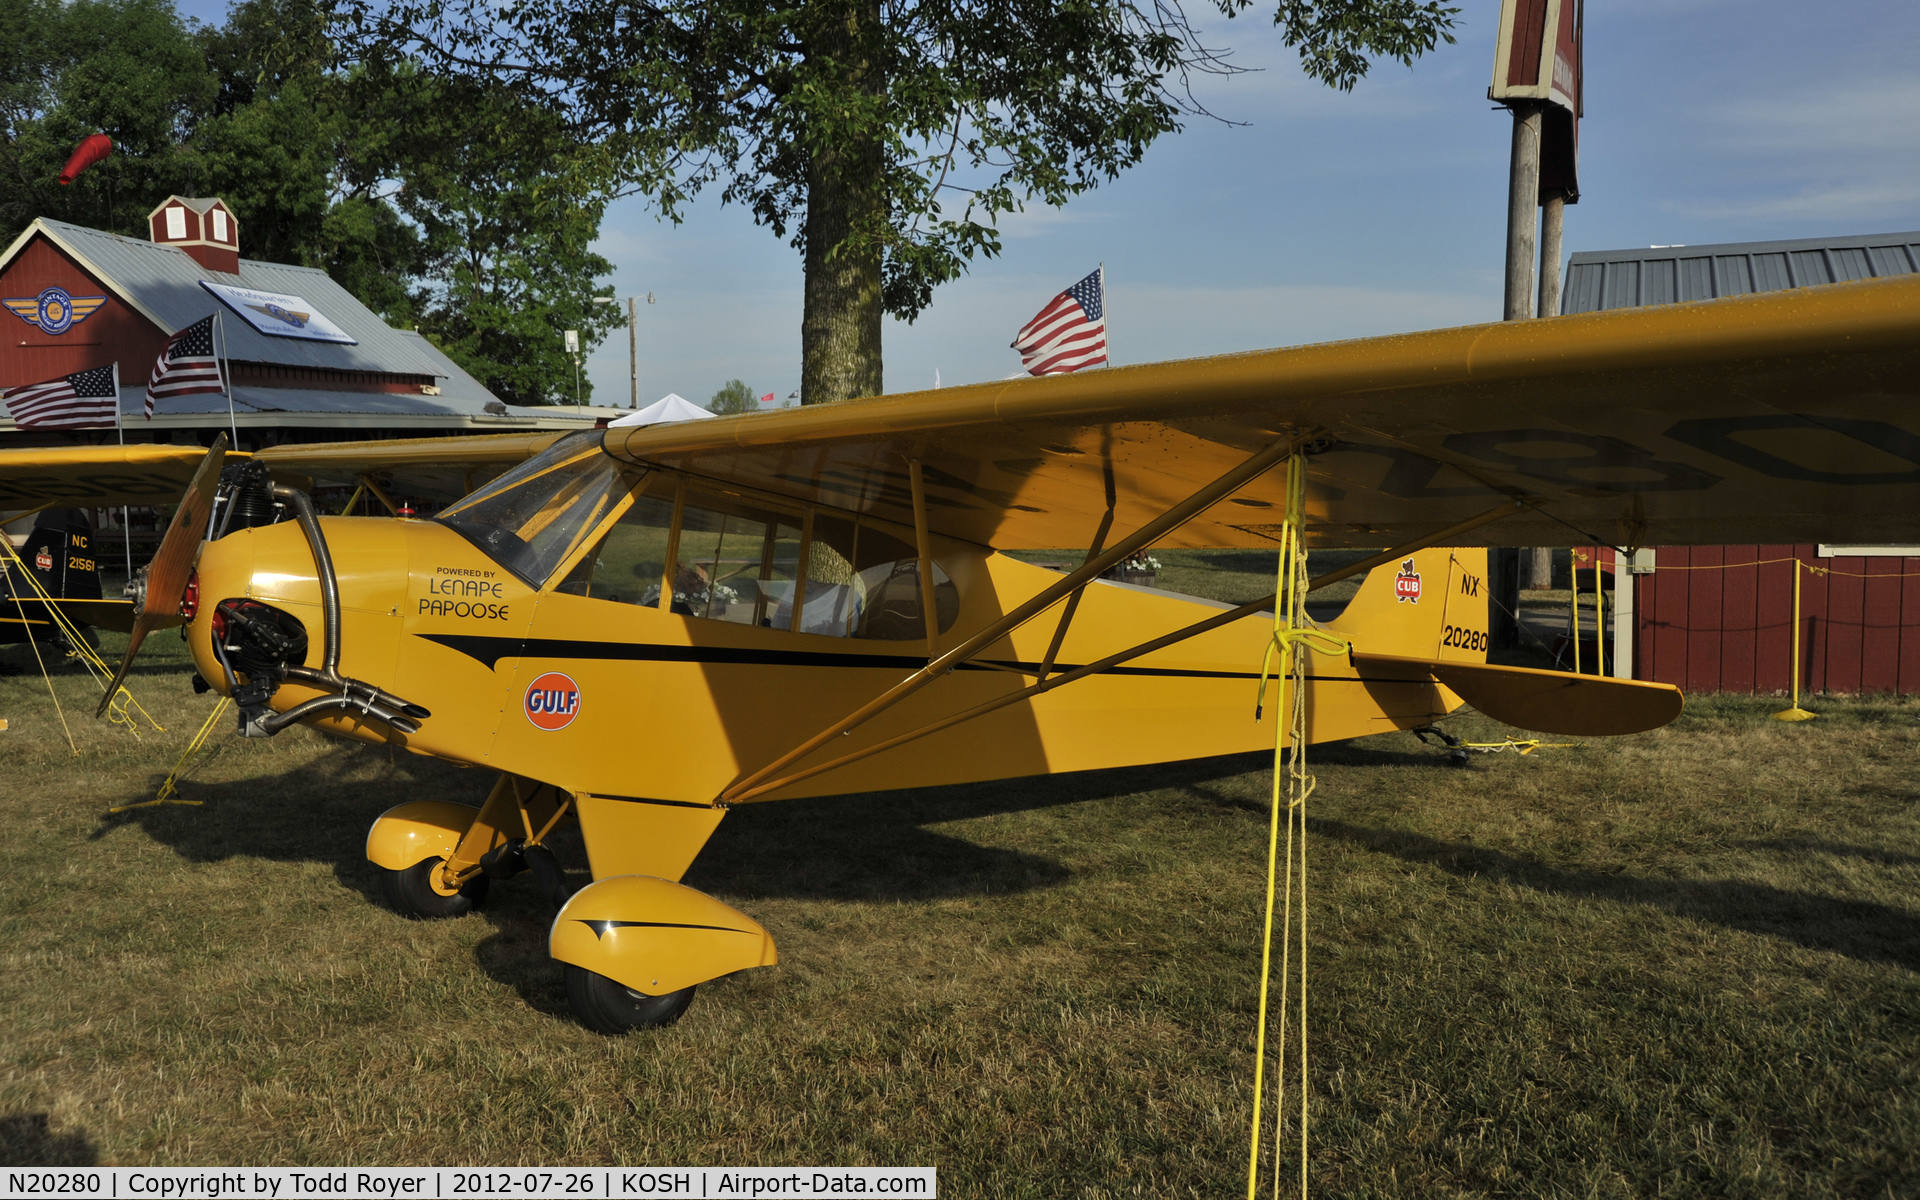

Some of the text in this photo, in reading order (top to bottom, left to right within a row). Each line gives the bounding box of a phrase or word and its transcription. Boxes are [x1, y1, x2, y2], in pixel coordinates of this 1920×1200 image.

[42, 294, 68, 307] VINTAGE
[72, 534, 87, 548] NC
[37, 557, 51, 565] CUB
[69, 557, 95, 572] 21561
[437, 567, 495, 578] POWERED BY
[430, 578, 502, 598] LENAPE
[1397, 580, 1419, 592] CUB
[1461, 574, 1479, 597] NX
[419, 599, 509, 620] PAPOOSE
[1443, 625, 1488, 652] 20280
[528, 689, 578, 715] GULF
